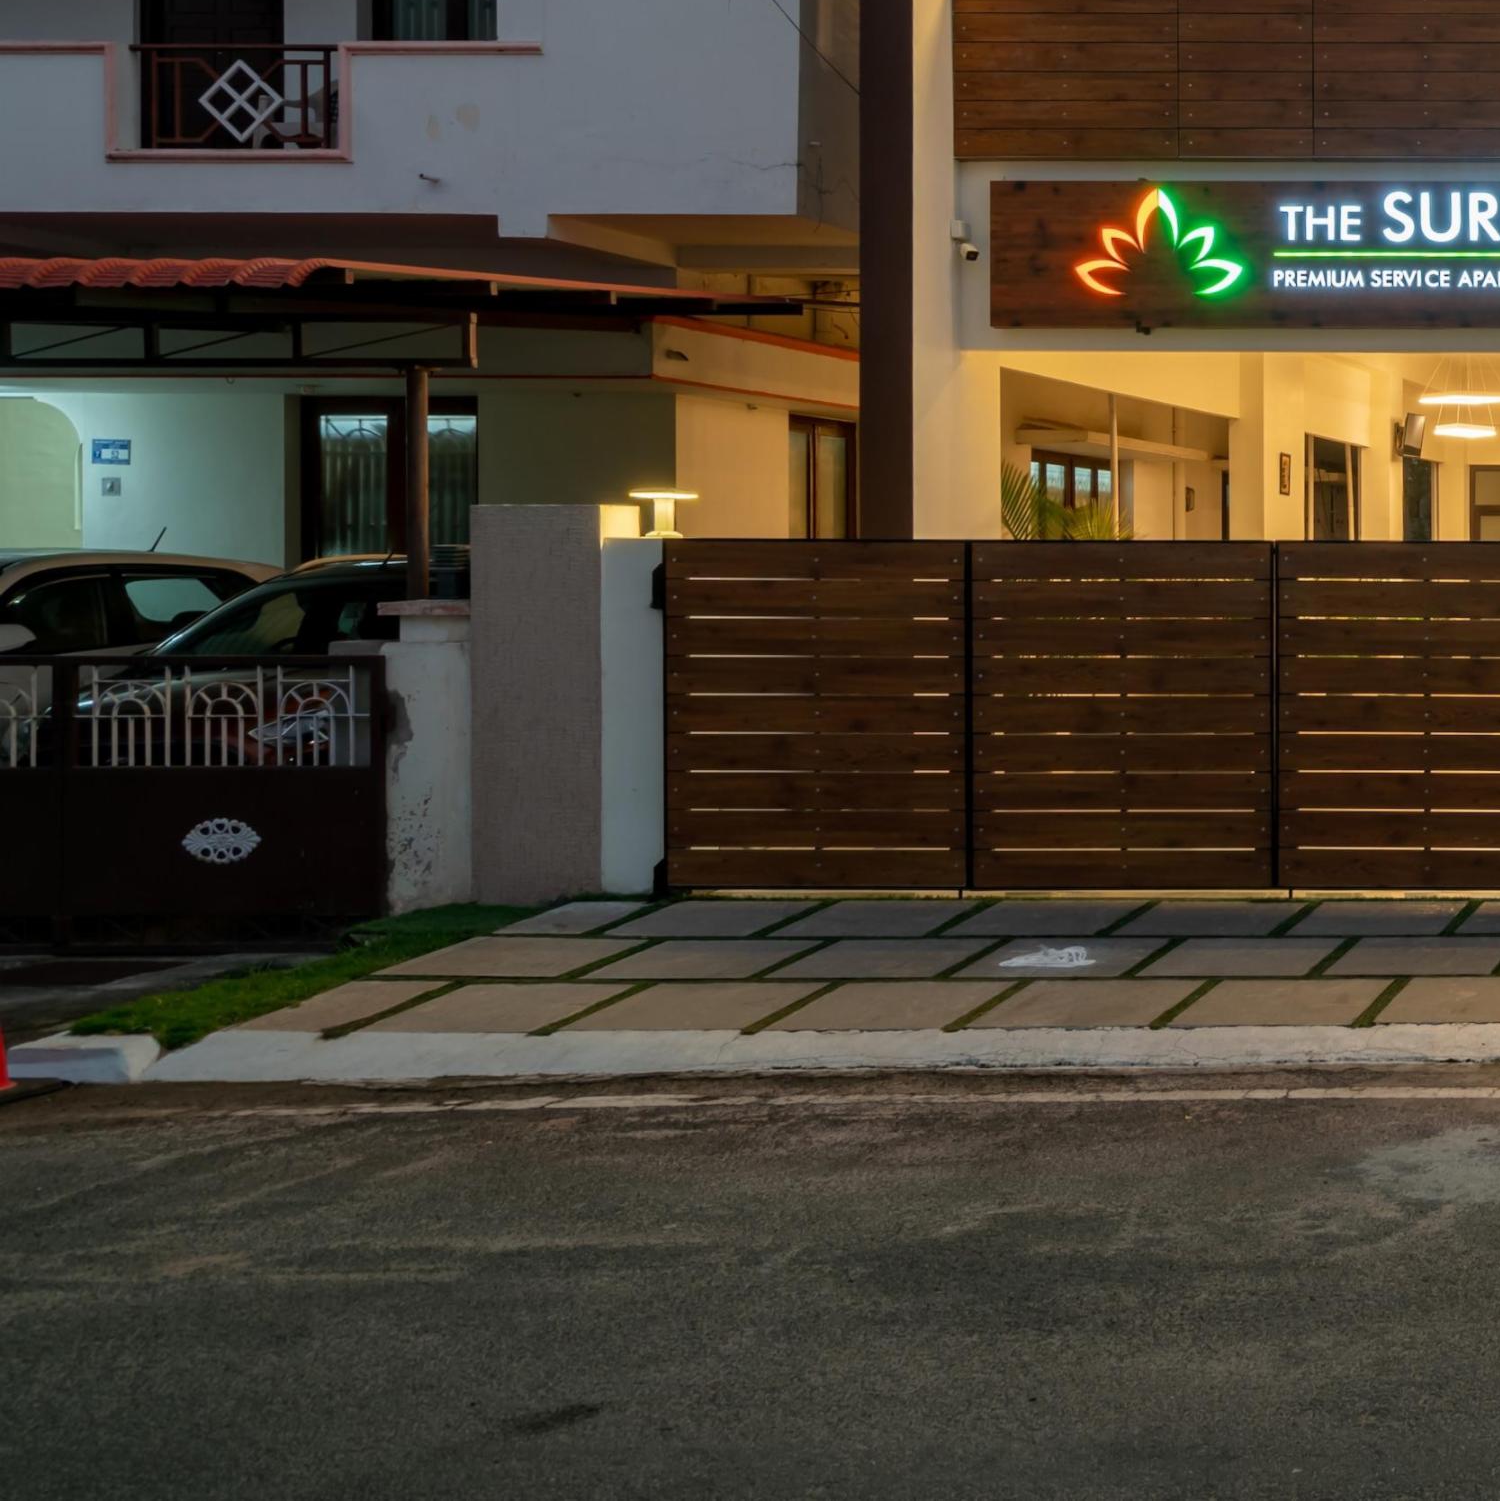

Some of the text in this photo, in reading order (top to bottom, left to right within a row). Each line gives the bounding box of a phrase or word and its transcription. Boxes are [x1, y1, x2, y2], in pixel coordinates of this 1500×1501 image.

[1279, 204, 1362, 241] THE
[1273, 269, 1364, 288] PREMIUM
[1370, 269, 1450, 288] SERVICE
